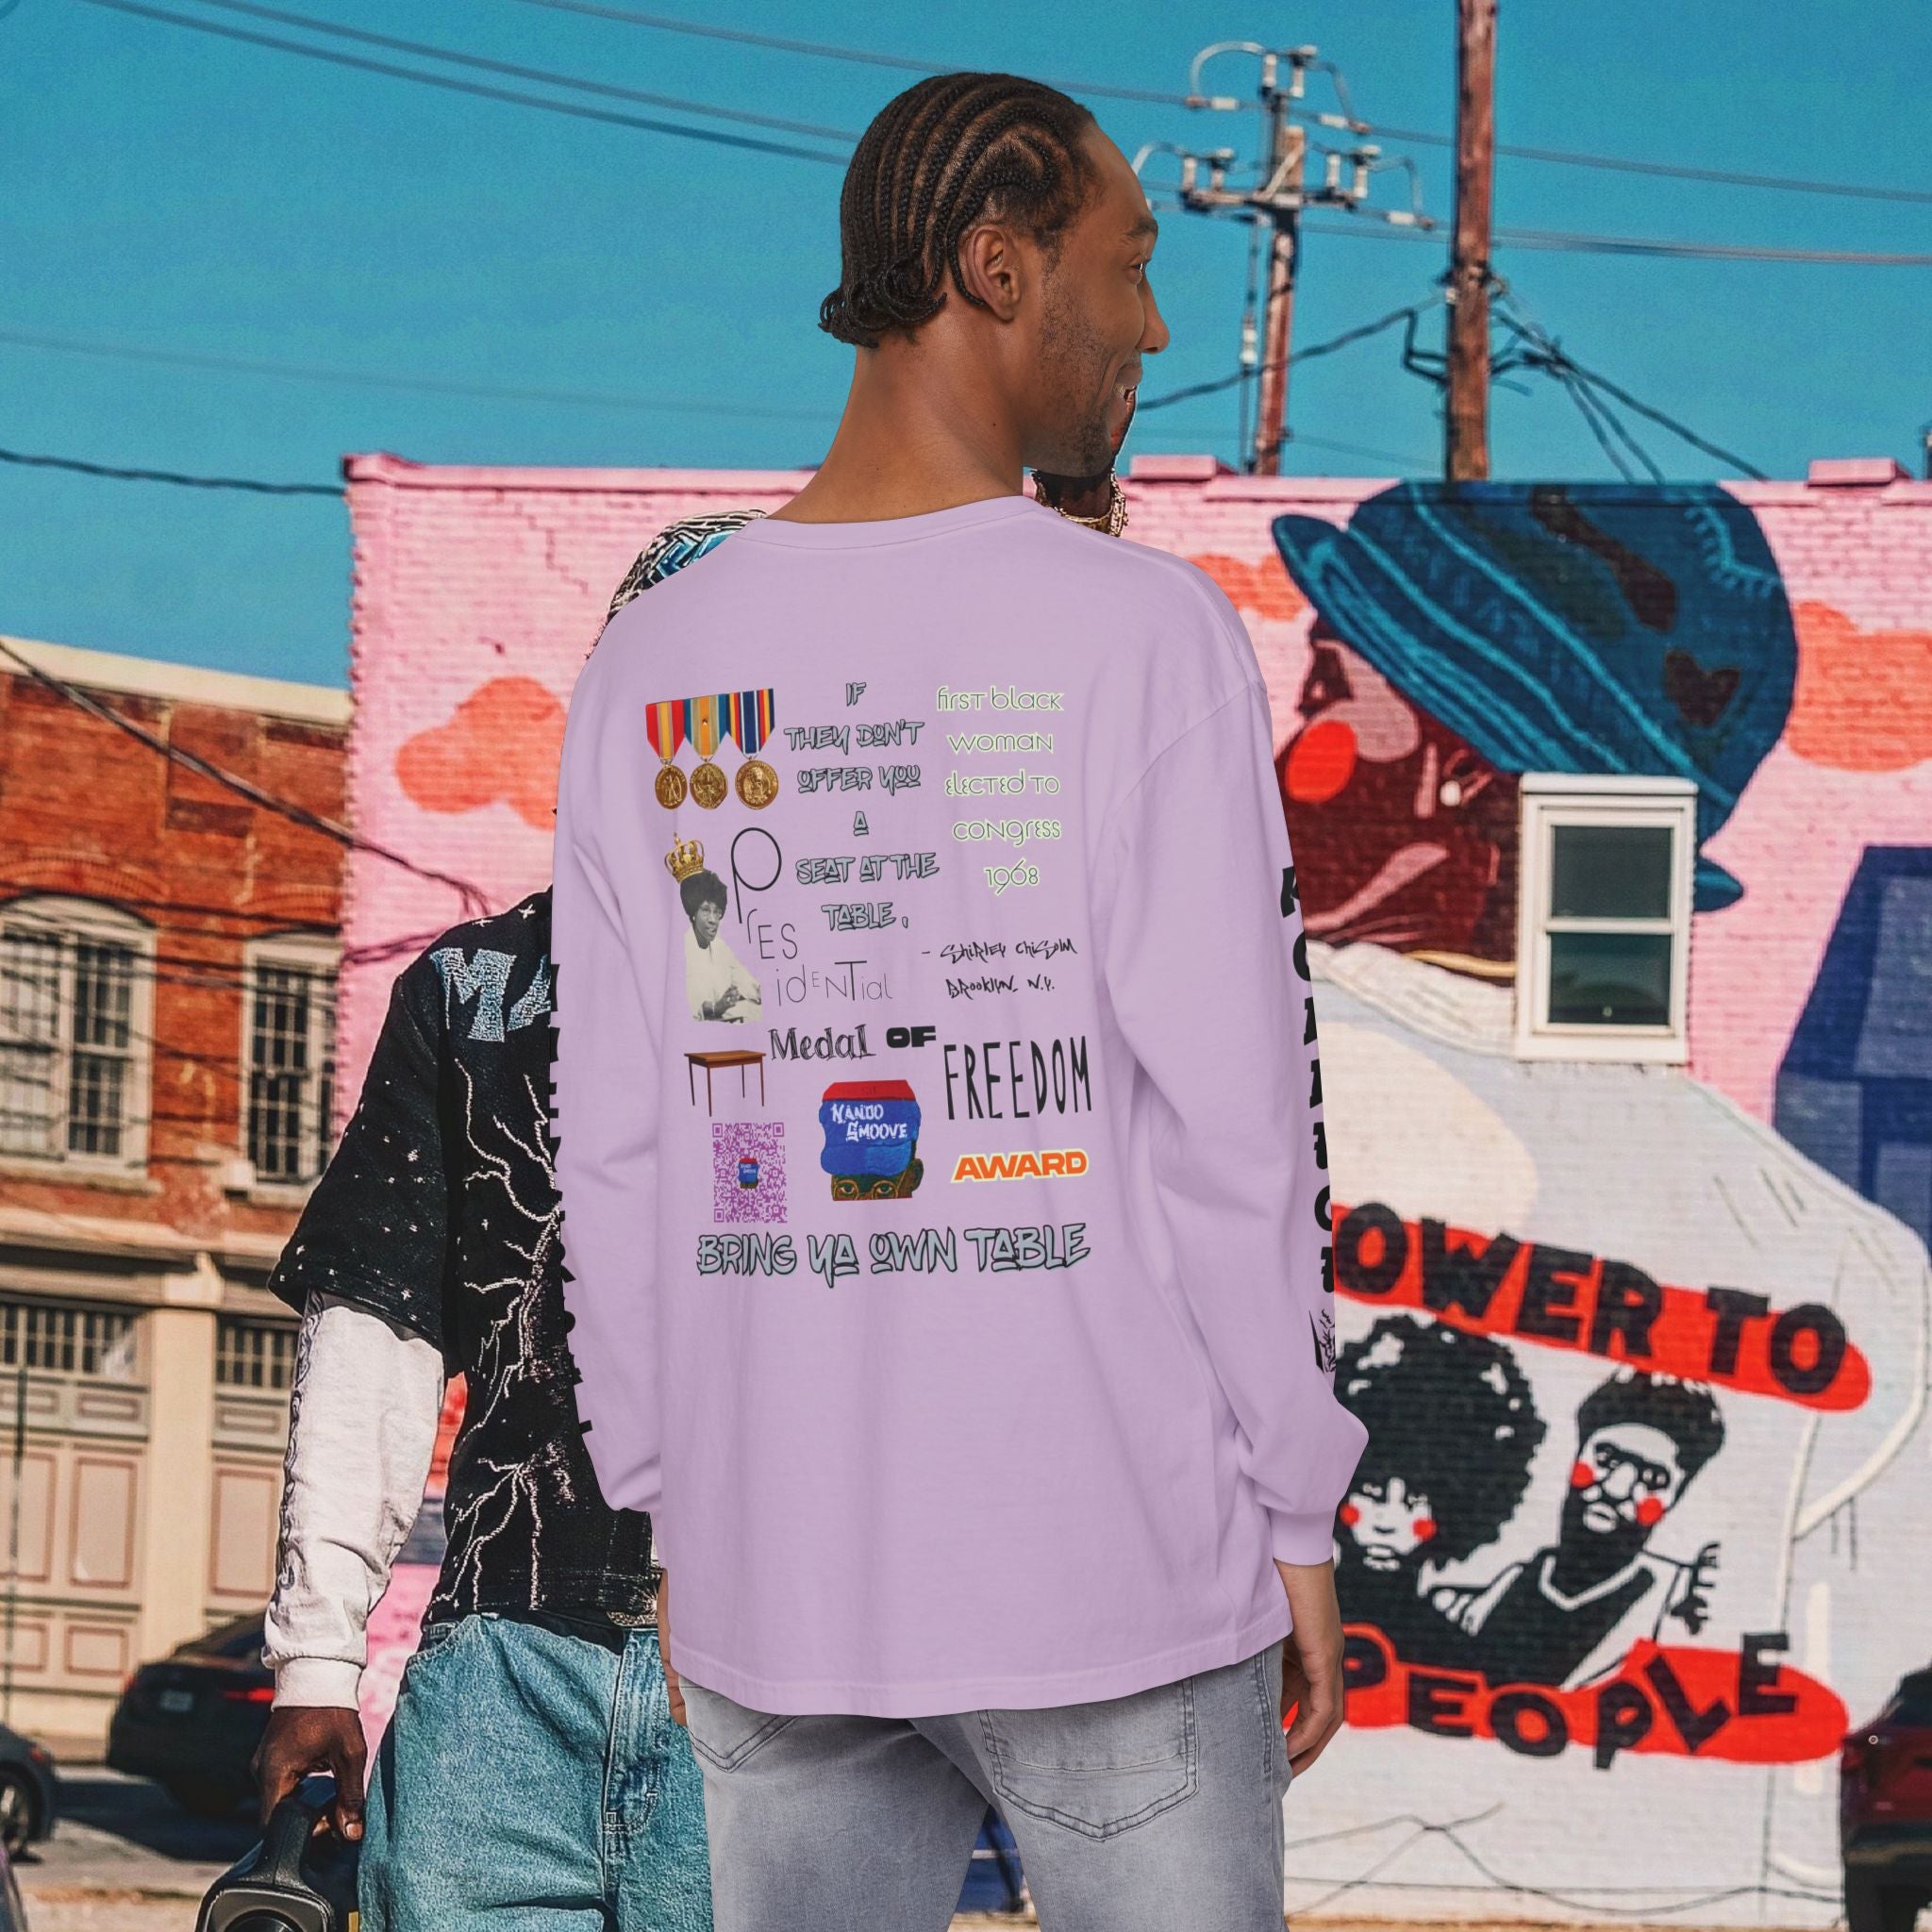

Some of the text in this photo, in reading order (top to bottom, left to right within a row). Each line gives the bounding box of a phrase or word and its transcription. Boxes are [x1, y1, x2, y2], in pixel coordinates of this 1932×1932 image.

[845, 681, 867, 707] IF
[783, 718, 925, 756] THEY DON'T
[797, 764, 922, 797] OFFER YOU
[853, 810, 869, 837] A
[795, 852, 941, 885] SEAT AT THE
[983, 856, 1041, 897] 1968
[768, 1024, 936, 1062] Medal OF
[943, 1036, 1091, 1120] FREEDOM
[830, 1103, 884, 1124] NANDO
[845, 1121, 908, 1142] SMOOVE
[951, 1149, 1090, 1183] AWARD
[696, 1223, 1091, 1289] BRING YA OWN TABLE
[1335, 1202, 1847, 1395] OWER TO
[1343, 1633, 1797, 1771] PEOPLE
